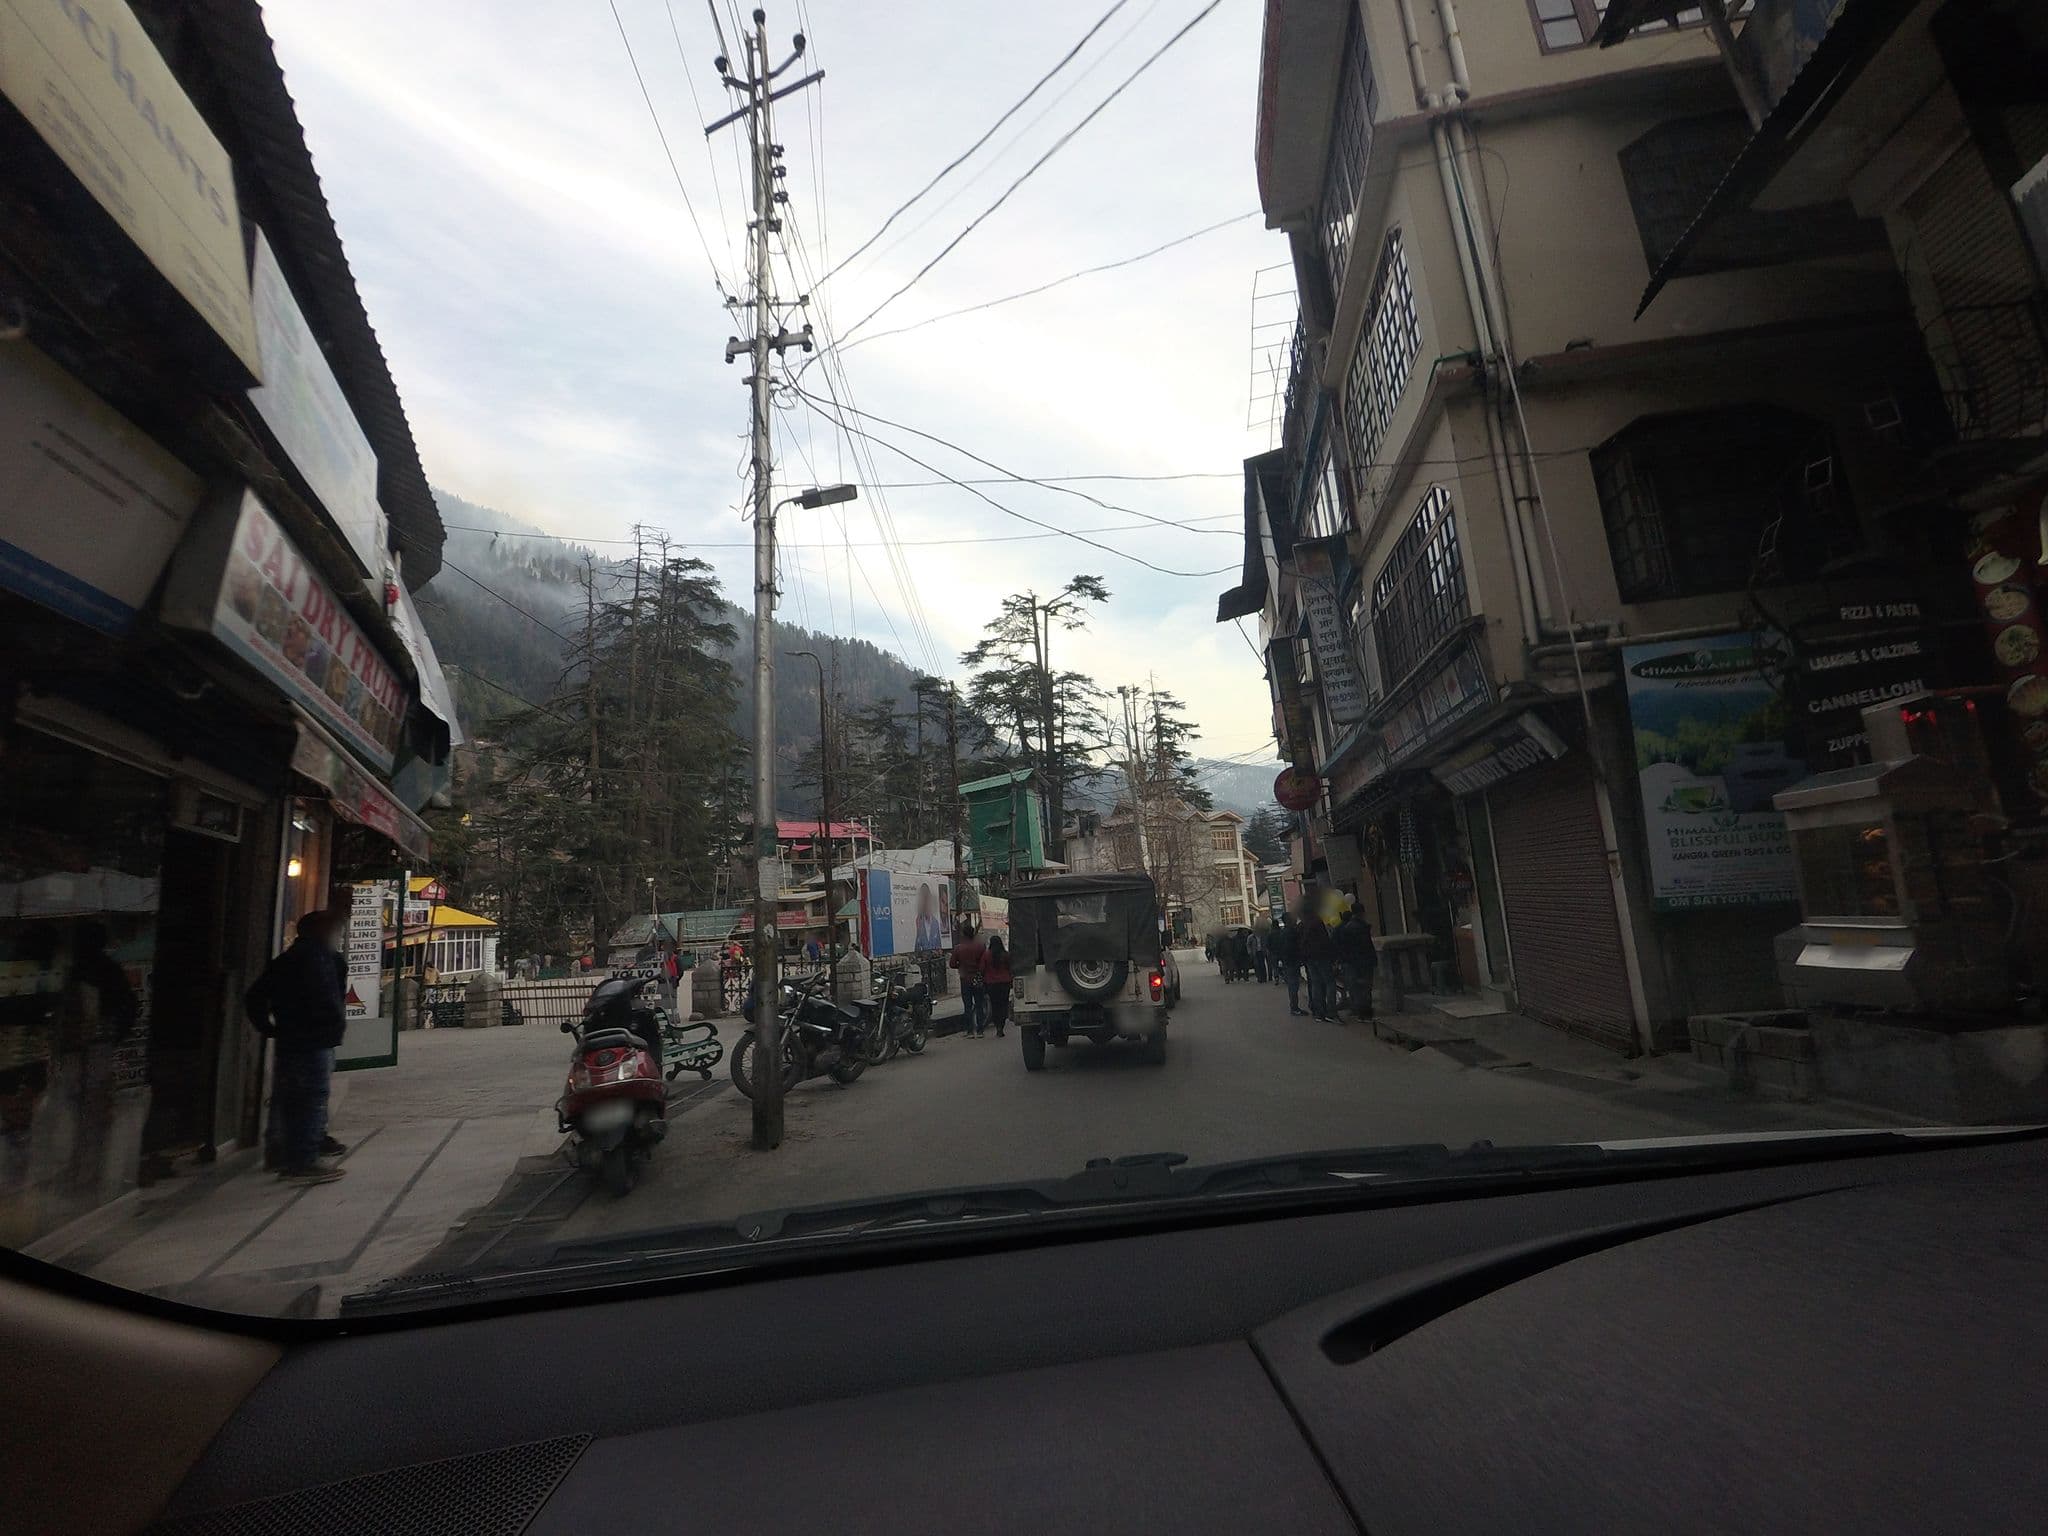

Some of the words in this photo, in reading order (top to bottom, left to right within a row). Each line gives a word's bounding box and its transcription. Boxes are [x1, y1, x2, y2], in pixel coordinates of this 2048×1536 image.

[302, 574, 352, 657] DRY
[1840, 604, 1872, 620] PIZZA
[1885, 602, 1921, 617] PASTA
[1808, 679, 1926, 713] CANNELLONI
[1499, 736, 1546, 773] SHOP
[1671, 833, 1744, 848] BLISSFUL
